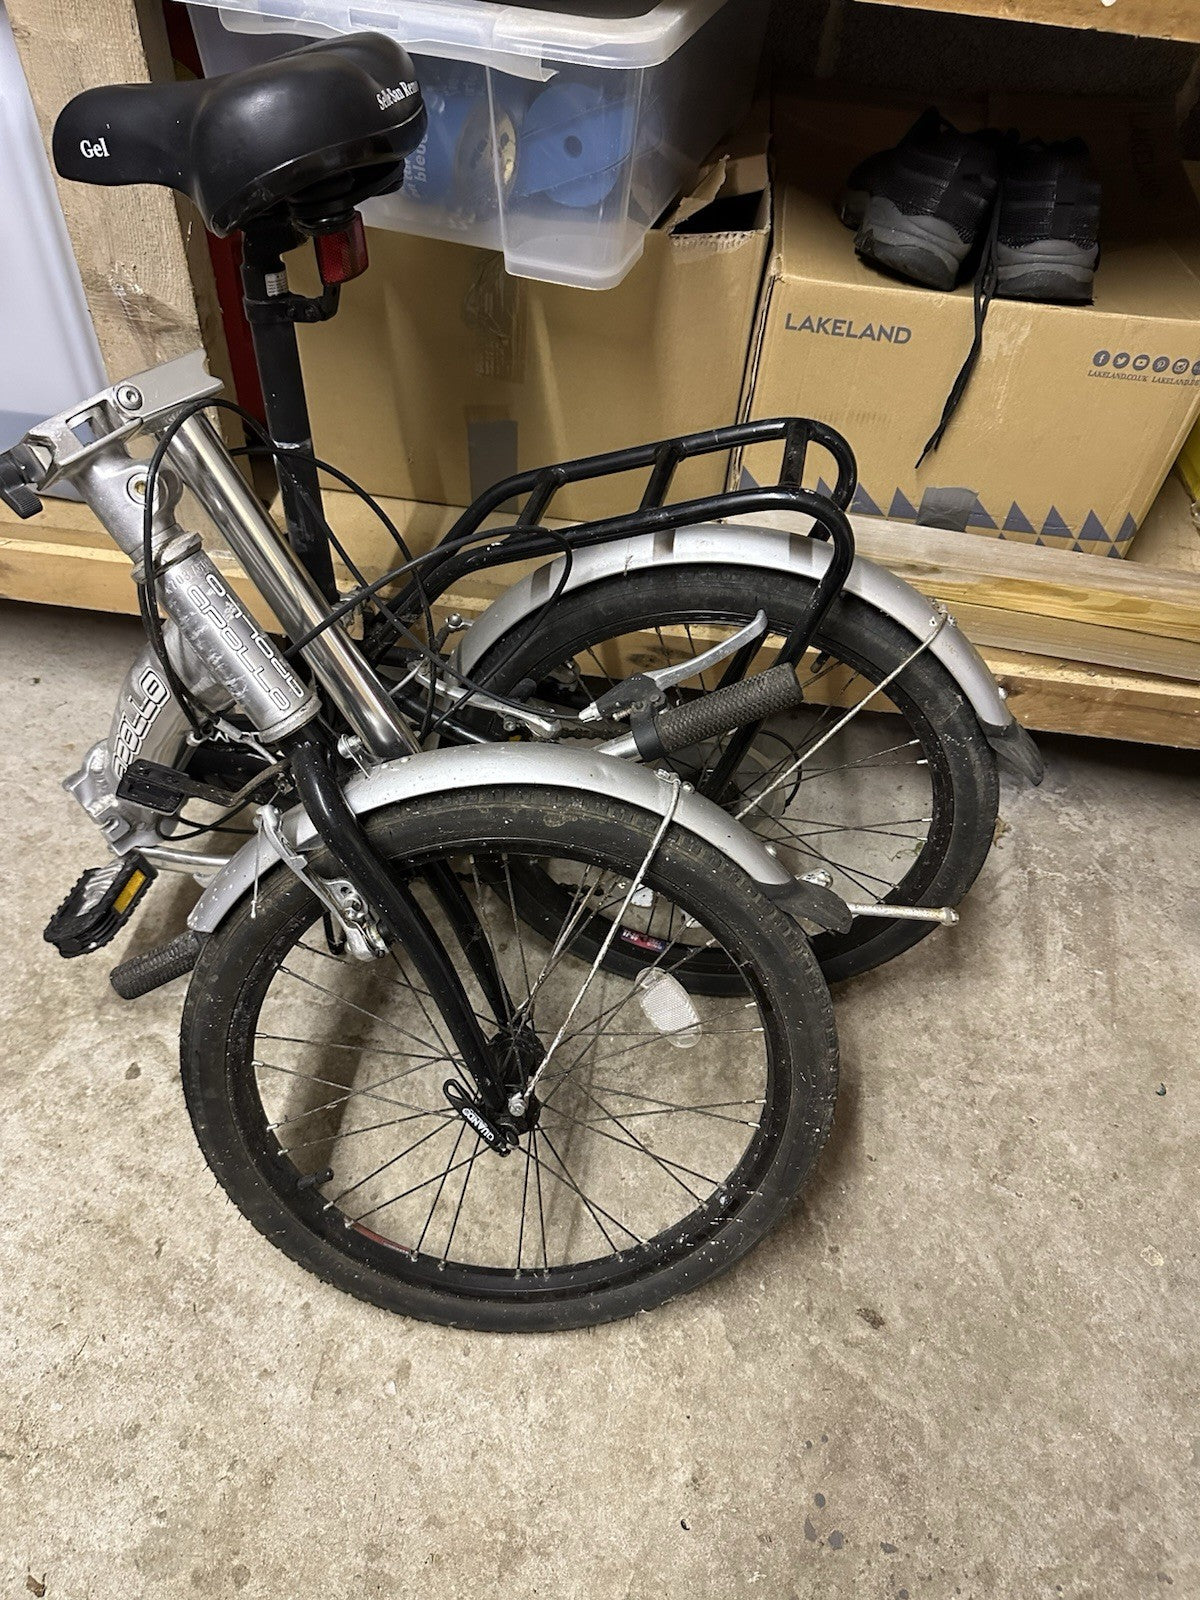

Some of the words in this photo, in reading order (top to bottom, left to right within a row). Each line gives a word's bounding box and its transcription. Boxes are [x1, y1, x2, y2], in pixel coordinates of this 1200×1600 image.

[80, 137, 110, 158] Gel
[784, 312, 912, 344] LAKELAND
[186, 584, 292, 712] APOLLO
[205, 573, 305, 699] APOLLO
[461, 1107, 495, 1142] QUANDO
